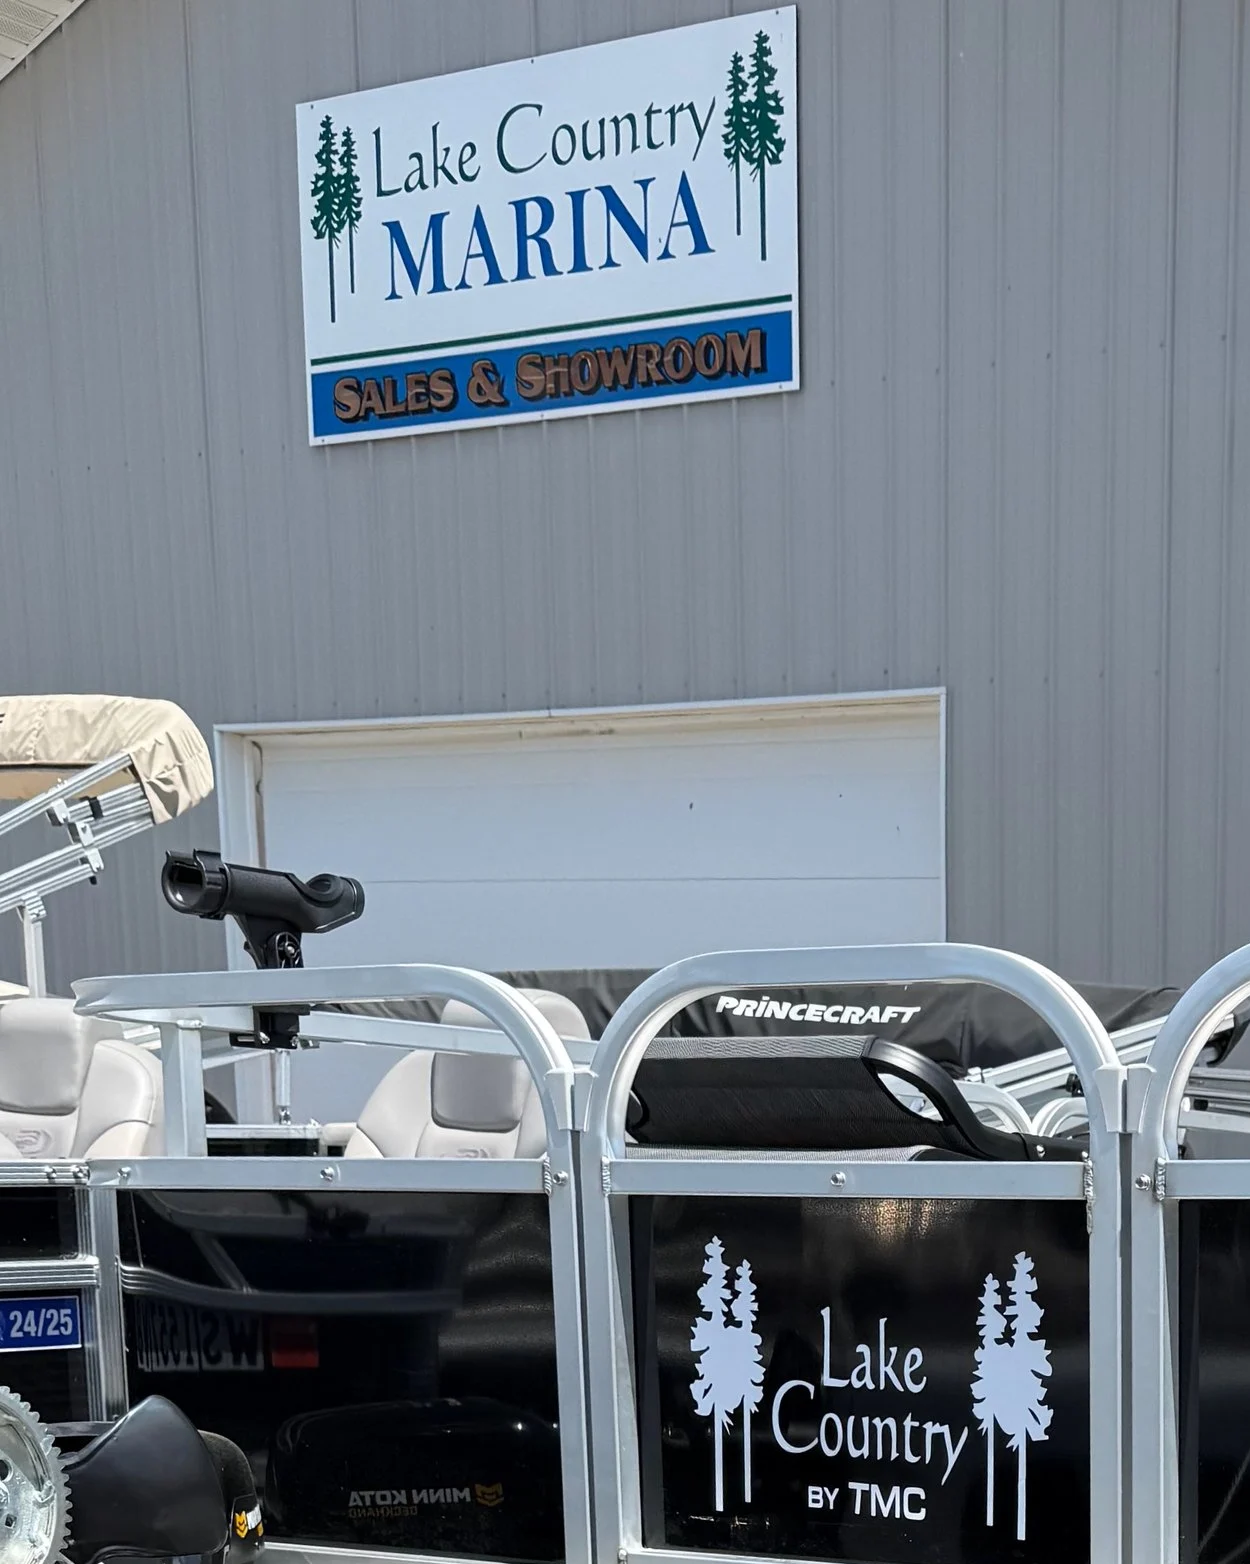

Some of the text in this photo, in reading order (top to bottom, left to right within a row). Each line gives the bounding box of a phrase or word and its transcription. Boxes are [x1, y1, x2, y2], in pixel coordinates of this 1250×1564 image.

[373, 97, 716, 199] Lake Country
[381, 170, 716, 300] MARINA
[333, 328, 768, 424] SALES & SHOWROOM
[715, 995, 922, 1025] PRINCECRAFT
[9, 1308, 73, 1338] 24/25
[820, 1306, 927, 1394] Lake
[772, 1379, 968, 1486] Country
[807, 1481, 927, 1521] BY TMC
